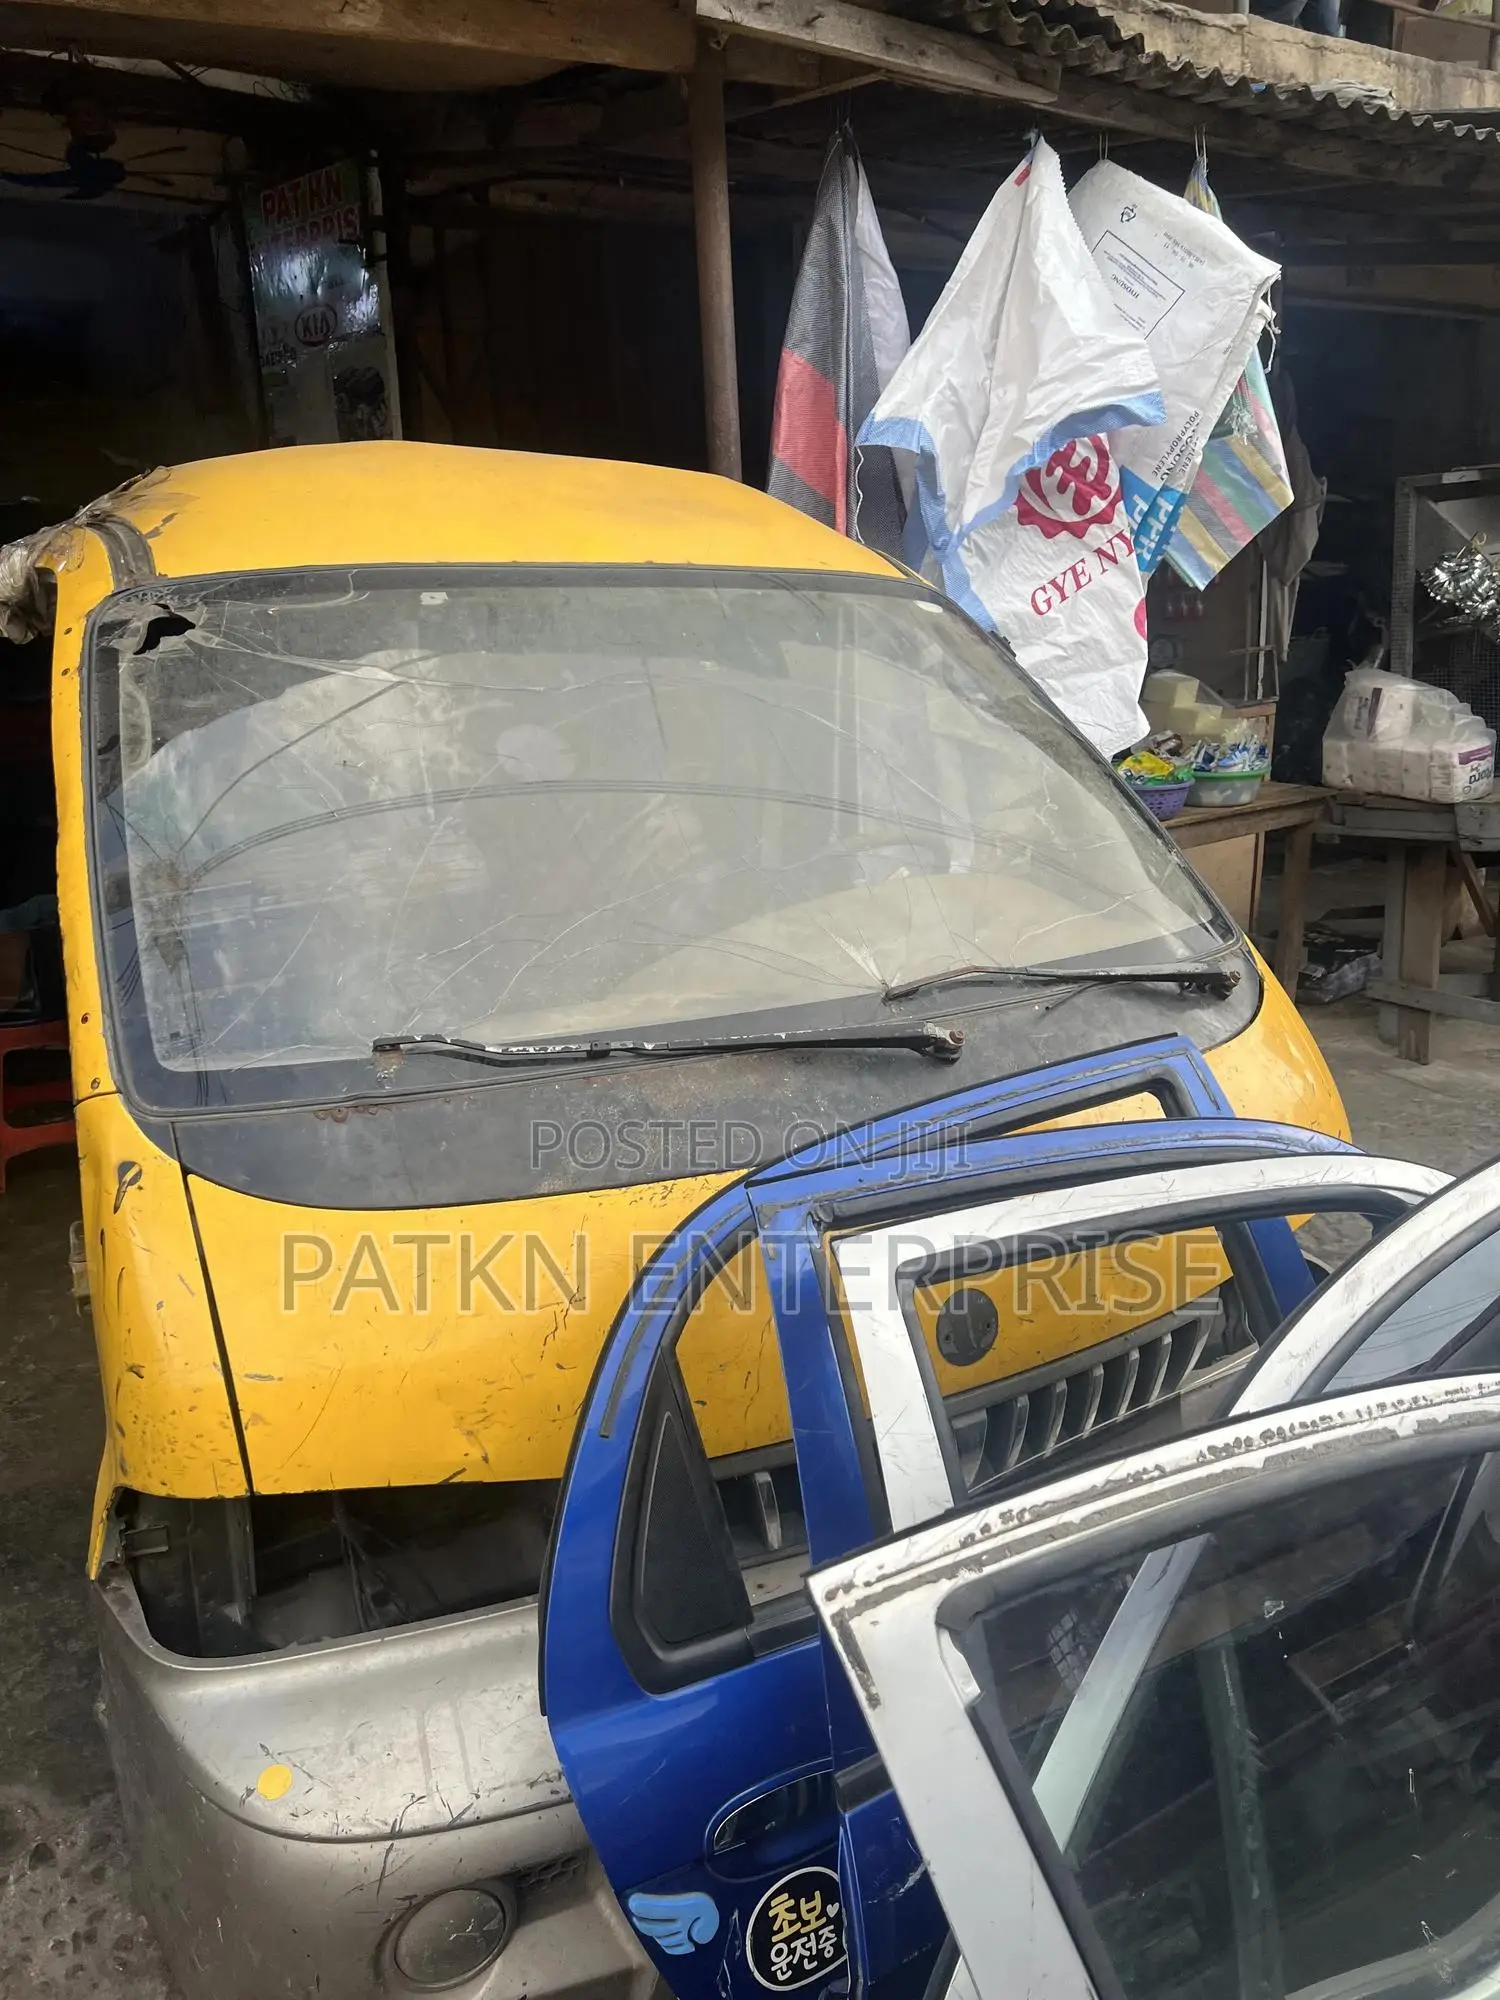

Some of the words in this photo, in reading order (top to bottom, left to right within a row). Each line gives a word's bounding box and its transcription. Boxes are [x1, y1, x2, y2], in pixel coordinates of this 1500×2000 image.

[301, 311, 331, 338] KIA
[1152, 410, 1199, 478] POLYPROPYLENE
[1030, 557, 1092, 616] GYE
[768, 1890, 827, 1943] 초보
[770, 1924, 838, 1981] 운전중
